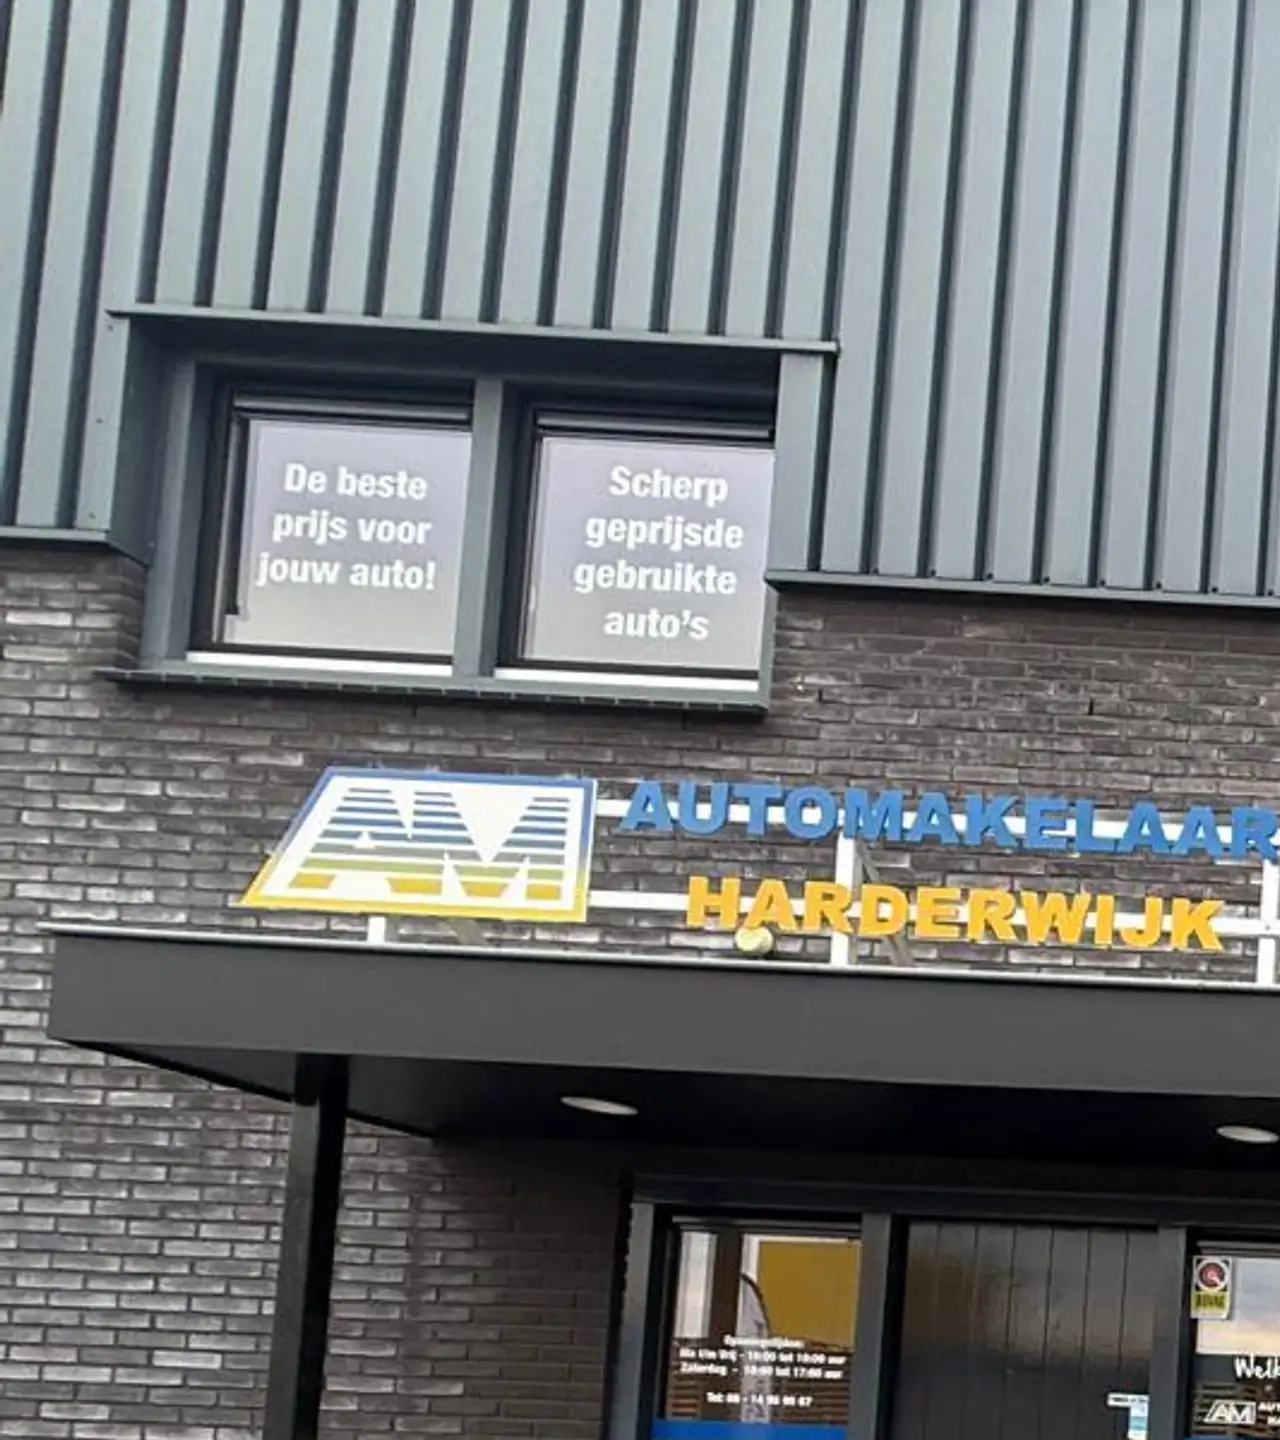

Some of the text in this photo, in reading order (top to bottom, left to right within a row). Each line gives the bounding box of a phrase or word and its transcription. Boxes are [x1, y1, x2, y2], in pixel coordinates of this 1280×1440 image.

[284, 464, 427, 499] De beste
[610, 465, 728, 507] Scherp
[272, 509, 431, 546] prijs voor
[585, 513, 743, 552] geprijsde
[255, 551, 436, 591] jouw auto!
[574, 560, 737, 596] gebruikte
[604, 608, 709, 640] auto's
[288, 787, 571, 901] AM
[686, 875, 1224, 952] HARDERWIJK
[1212, 1402, 1250, 1423] AM
